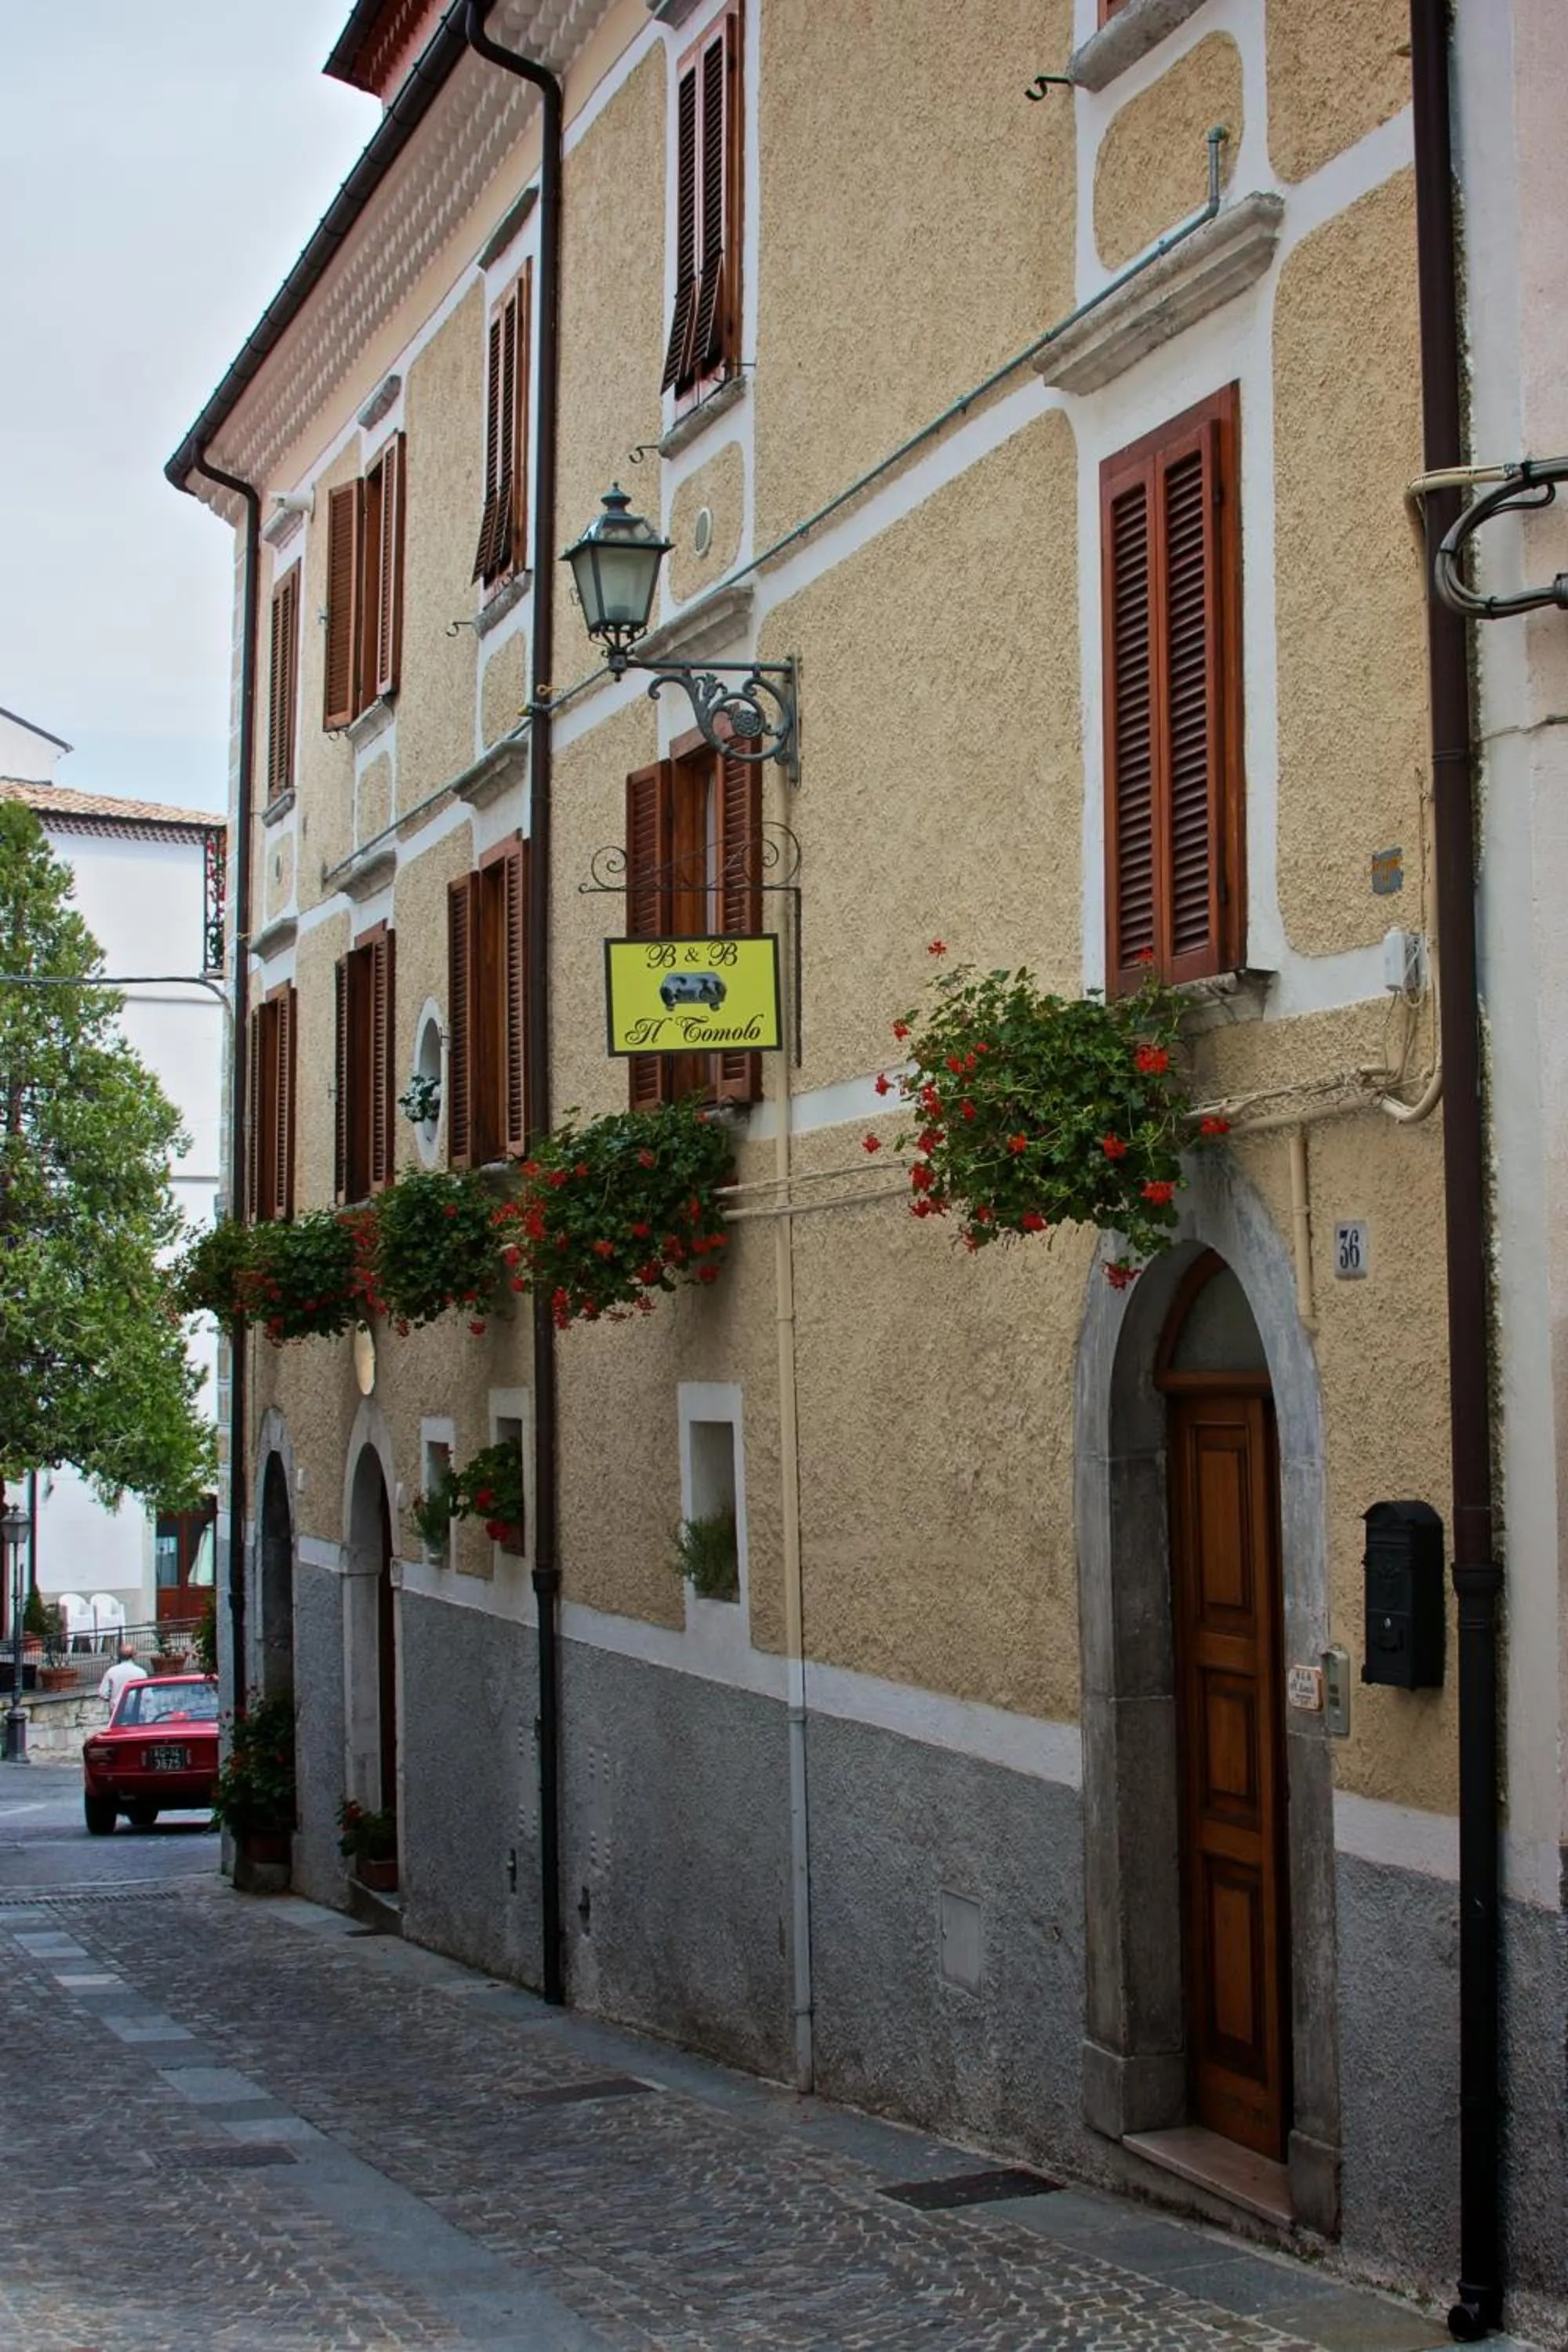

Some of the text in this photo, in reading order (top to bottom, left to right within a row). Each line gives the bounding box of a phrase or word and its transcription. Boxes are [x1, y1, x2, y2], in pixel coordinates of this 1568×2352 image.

[646, 941, 738, 968] B & B
[675, 1014, 764, 1044] Tomolo
[1339, 1229, 1360, 1269] 36
